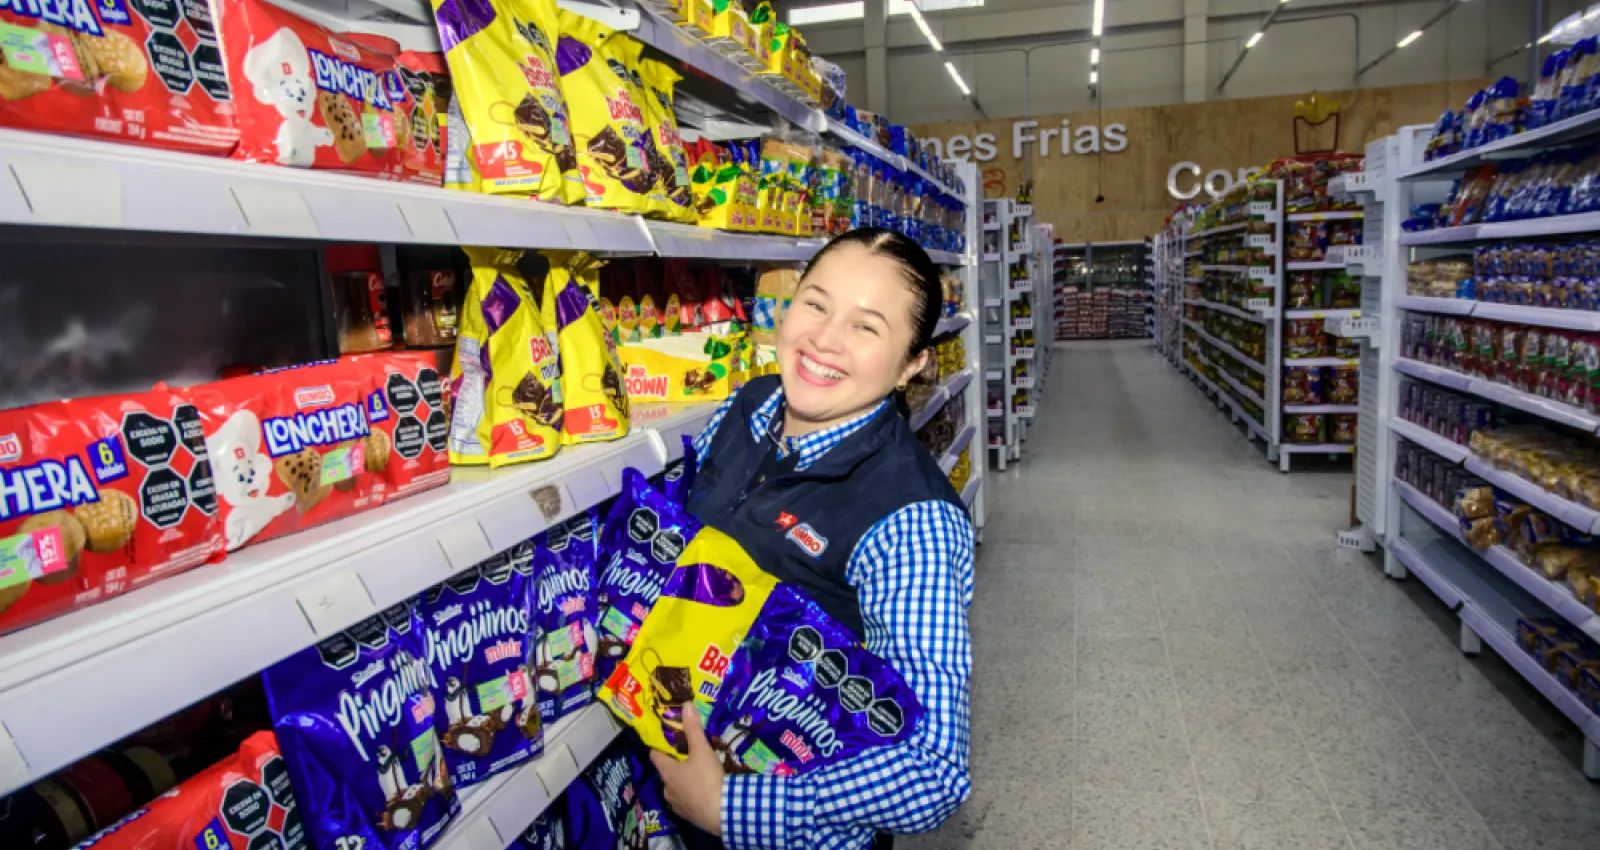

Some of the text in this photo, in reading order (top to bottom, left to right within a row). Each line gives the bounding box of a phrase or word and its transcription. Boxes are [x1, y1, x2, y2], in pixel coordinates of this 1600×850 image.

[0, 0, 102, 34] ERA
[310, 49, 393, 110] LONCHERA
[1012, 119, 1128, 159] Frias
[624, 376, 668, 397] ROWN
[373, 394, 382, 411] 6
[263, 403, 370, 457] LONCHERA
[97, 442, 114, 465] 6
[623, 675, 638, 693] 15
[737, 667, 844, 758] Pingüinos
[203, 828, 219, 850] 6
